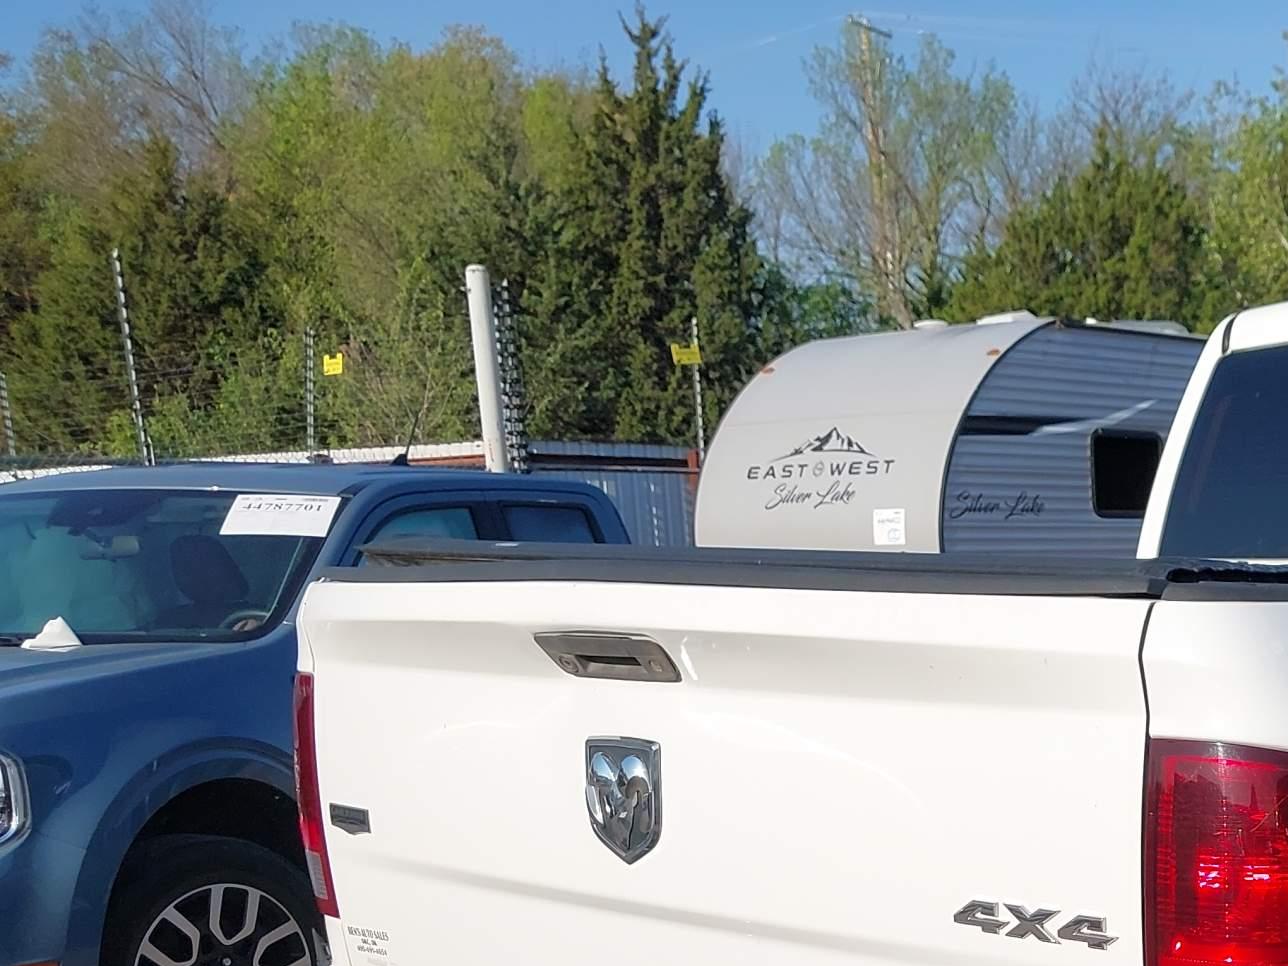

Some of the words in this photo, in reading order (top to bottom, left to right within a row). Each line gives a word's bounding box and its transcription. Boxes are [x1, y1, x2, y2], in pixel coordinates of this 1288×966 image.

[746, 463, 808, 480] EAST
[829, 459, 896, 477] WEST
[242, 502, 322, 512] 44787701
[764, 483, 812, 510] Silver
[813, 480, 856, 509] Lake
[953, 899, 1119, 951] 4X4
